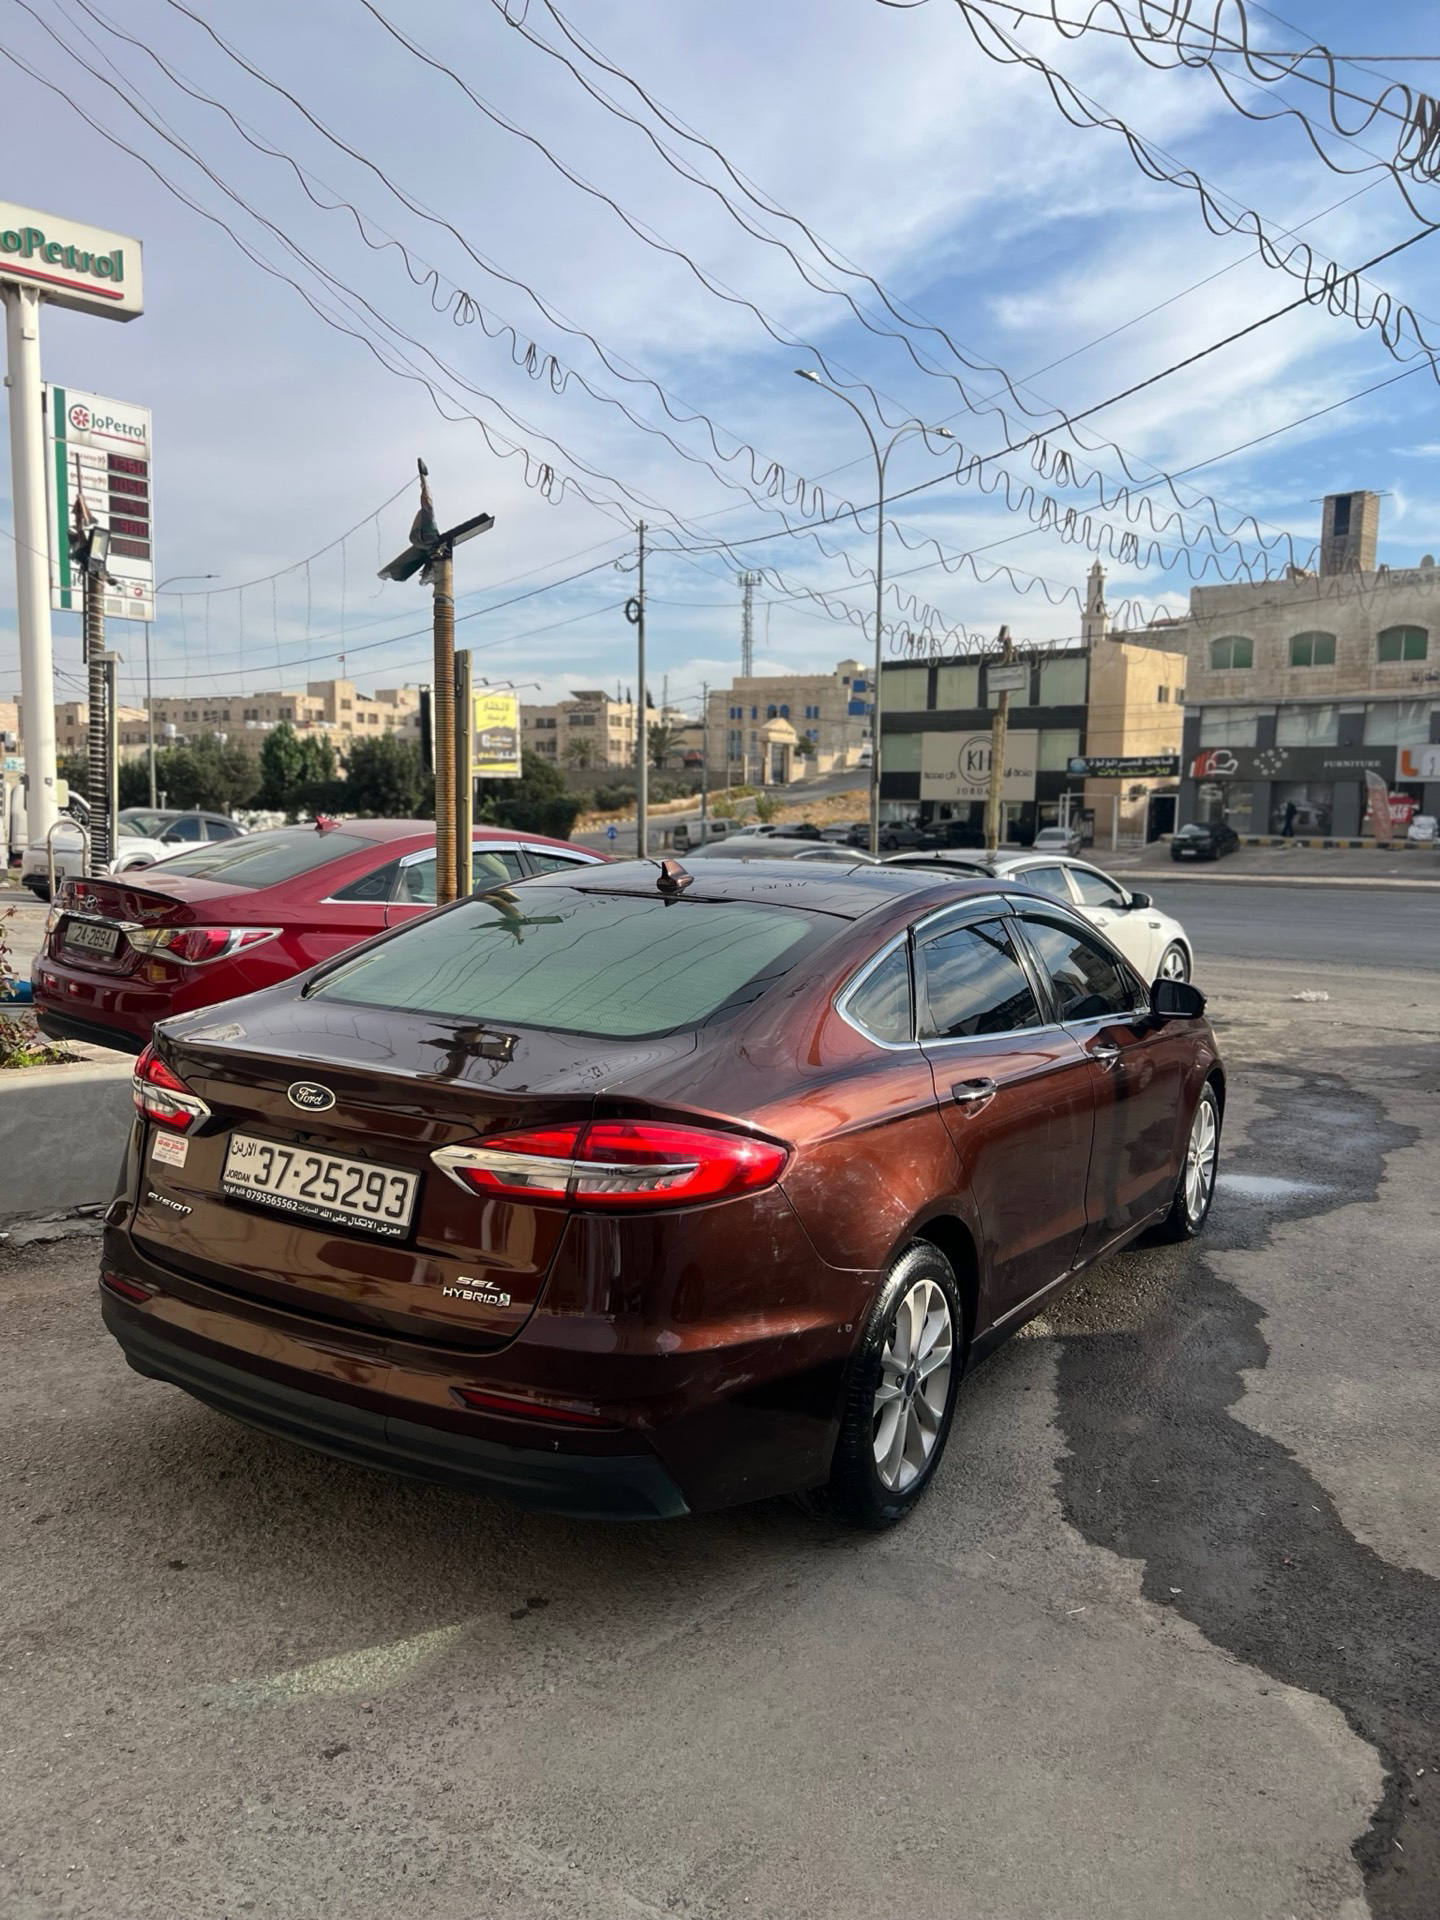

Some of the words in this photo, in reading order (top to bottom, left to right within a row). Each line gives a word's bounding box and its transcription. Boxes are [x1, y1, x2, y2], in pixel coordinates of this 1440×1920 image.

[0, 227, 124, 282] oPetrol
[91, 413, 146, 439] JoPetrol
[1323, 760, 1381, 768] FURNITURE
[957, 787, 991, 796] JORDA
[296, 1086, 324, 1105] Ford
[226, 1169, 251, 1183] JORDAN
[246, 1189, 298, 1211] 0795565562
[319, 1210, 333, 1219] الله
[332, 1214, 347, 1223] على
[377, 1223, 401, 1235] معرض
[456, 1276, 501, 1291] SEL
[442, 1286, 498, 1304] HYBRID
